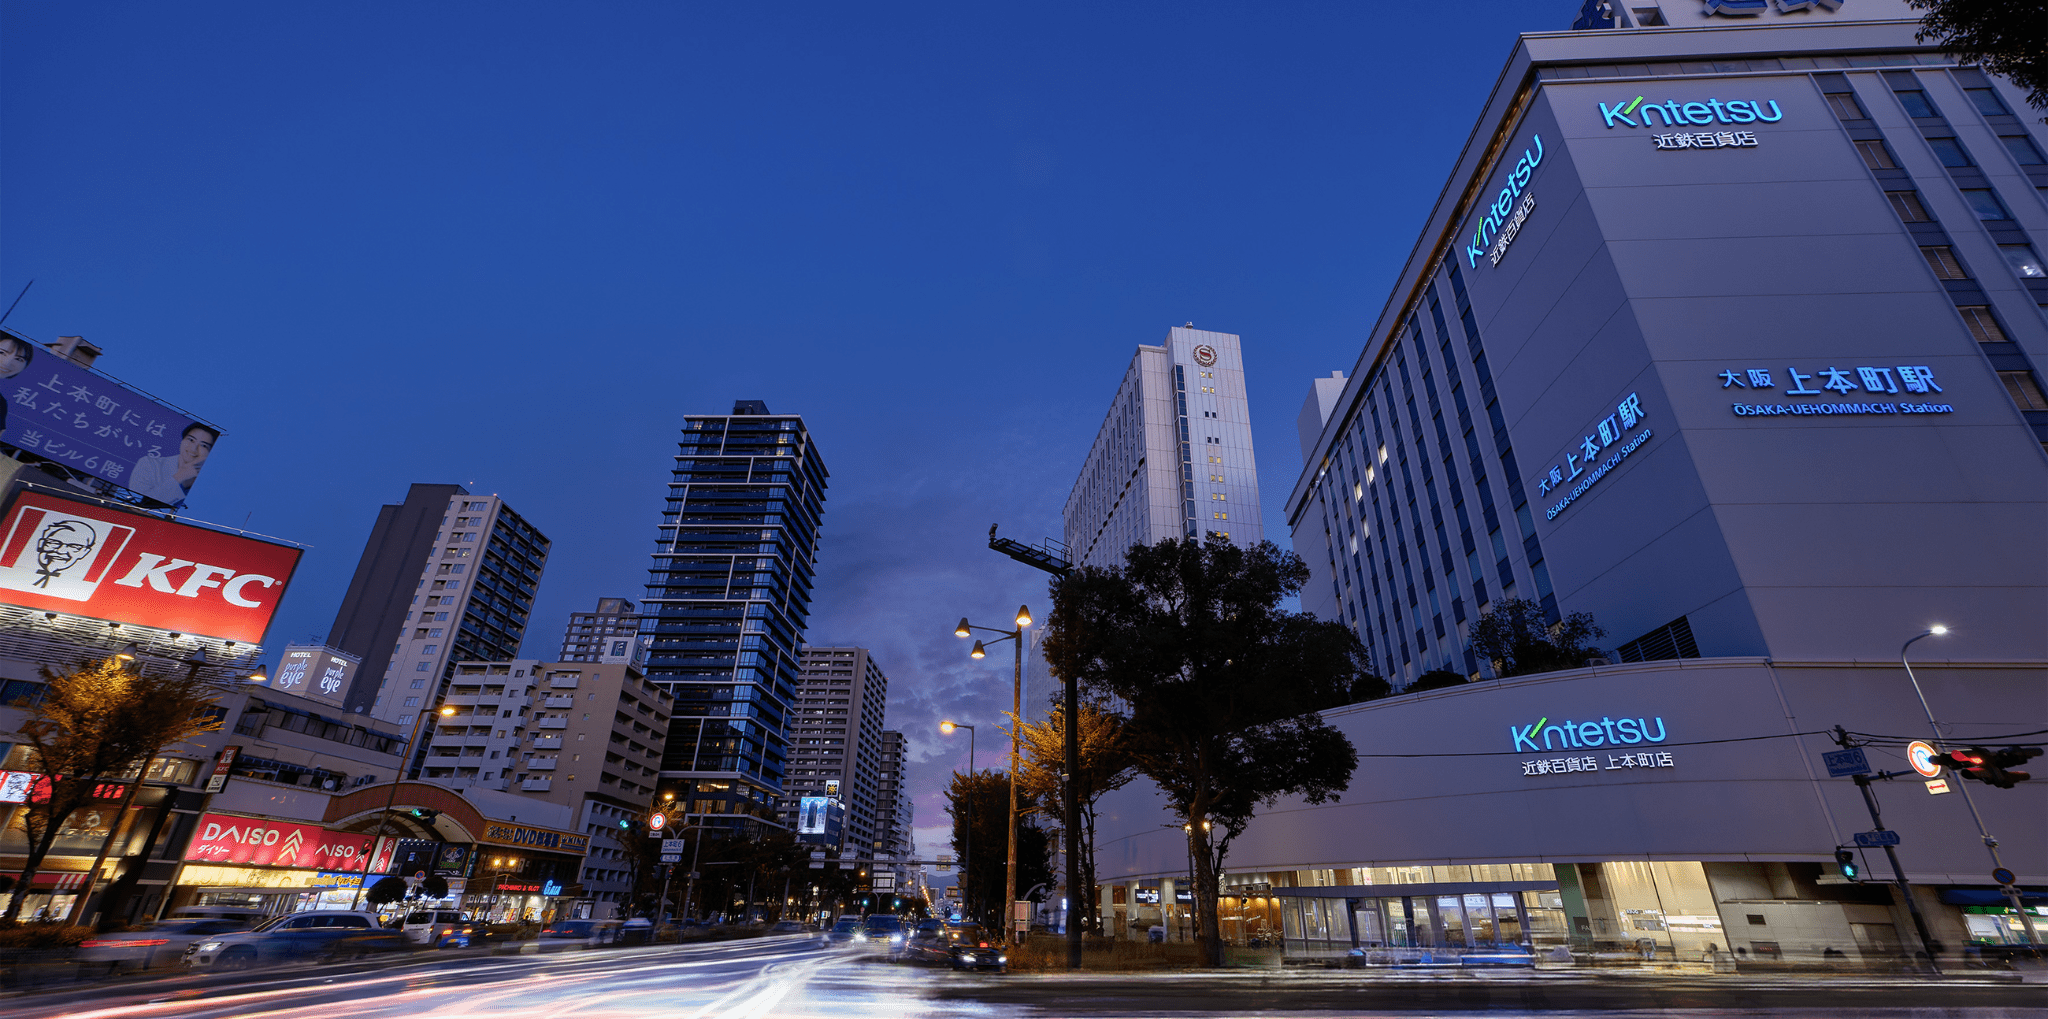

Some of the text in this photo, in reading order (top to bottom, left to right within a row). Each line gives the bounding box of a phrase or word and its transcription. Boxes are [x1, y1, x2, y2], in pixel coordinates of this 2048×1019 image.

[1598, 95, 1783, 129] Kintetsu
[1652, 131, 1759, 149] 近鉄百貨店
[1467, 133, 1544, 269] Kintetsu
[1490, 191, 1536, 268] 近鉄百貨店
[1718, 366, 1943, 396] 大阪 上本町駅
[37, 373, 167, 438] 上本町には
[1900, 402, 1954, 414] Station
[13, 386, 162, 459] 私たちがいる
[19, 429, 125, 479] 当ビル6階
[1539, 391, 1645, 497] 大阪 上本町駅
[1621, 428, 1652, 458] Station
[114, 552, 276, 608] KFC
[284, 658, 308, 672] purple
[330, 656, 348, 667] HOTEL
[279, 671, 305, 689] eye
[320, 676, 341, 694] eye
[1510, 716, 1667, 753] Kintetsu
[1521, 751, 1674, 776] 近鉄百貨店 上本町店
[201, 822, 280, 846] DAISO
[197, 844, 230, 855] ダイソー
